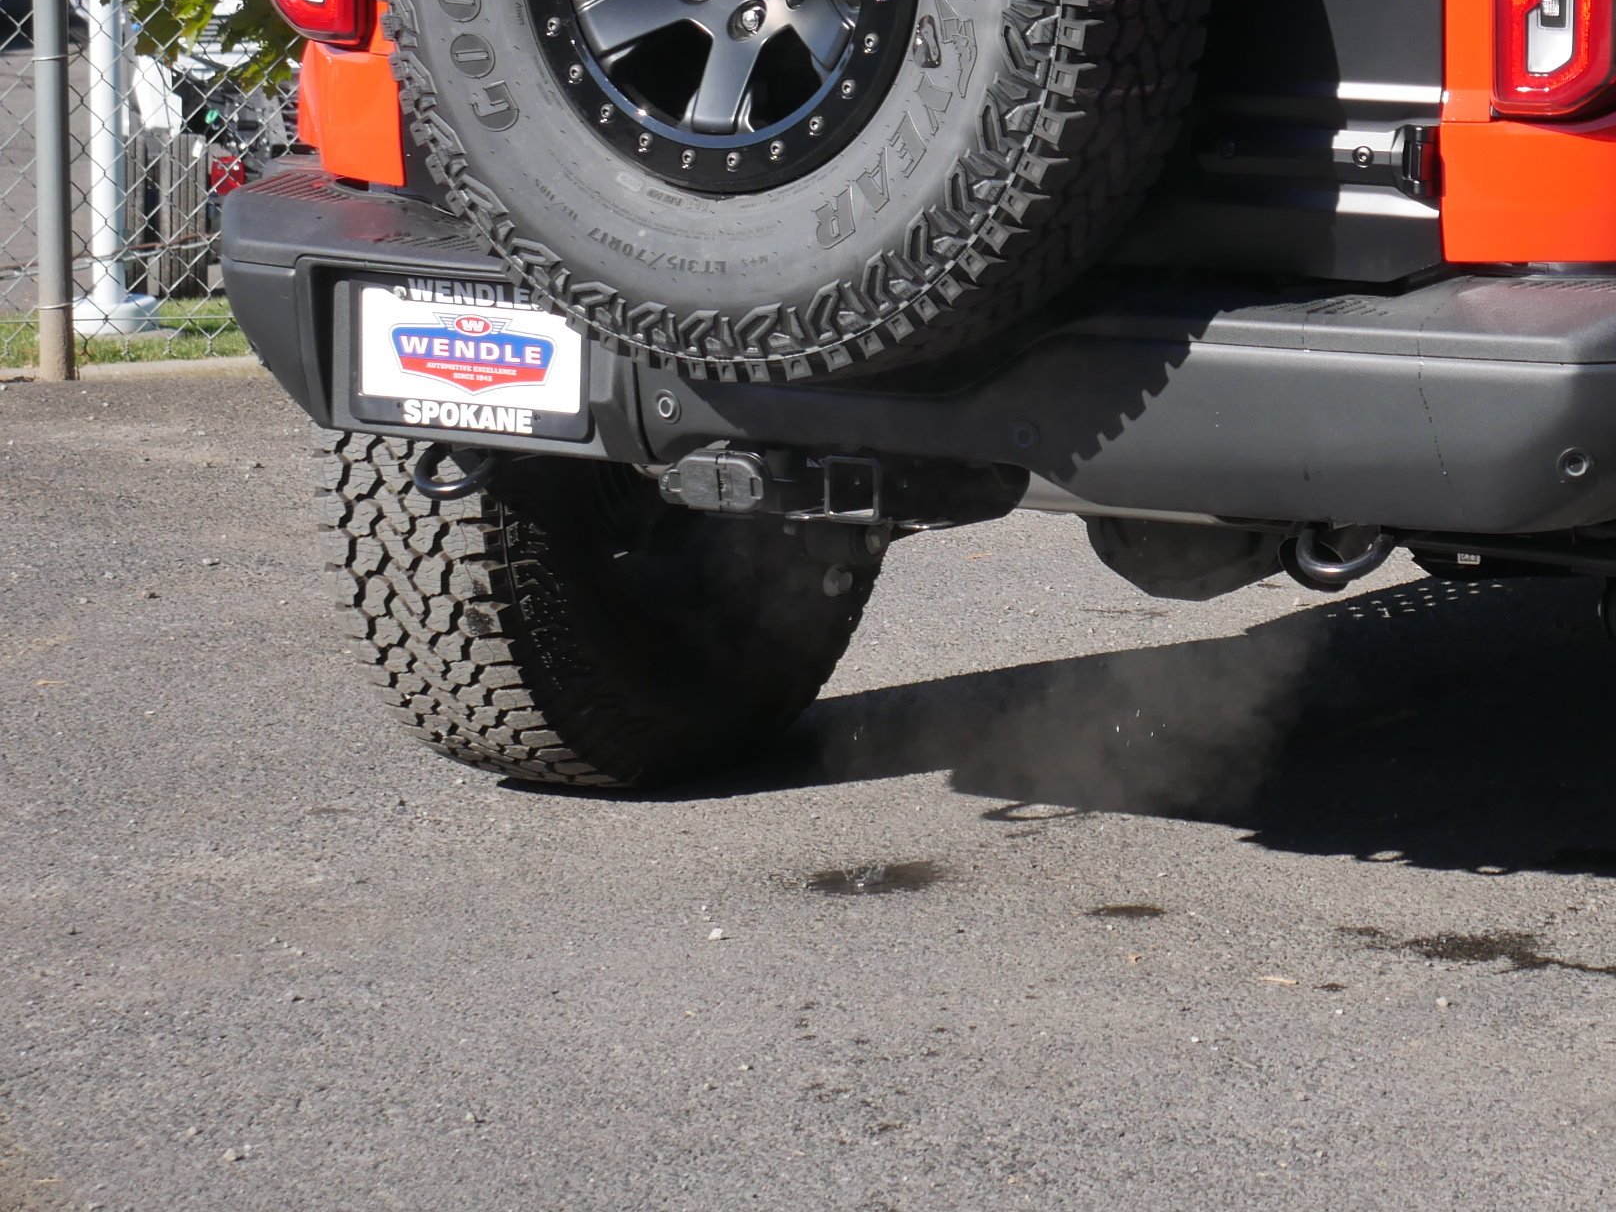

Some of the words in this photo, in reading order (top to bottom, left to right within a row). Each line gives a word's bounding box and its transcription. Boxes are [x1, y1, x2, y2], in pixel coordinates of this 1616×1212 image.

[586, 226, 727, 275] LT315/70R17
[408, 278, 540, 311] WENDLE
[461, 319, 485, 332] W
[400, 336, 542, 365] WENDLE
[426, 362, 472, 372] AUTOMOTIVE
[473, 366, 518, 376] EXCELLENCE
[453, 372, 475, 381] SINCE
[403, 398, 533, 434] SPOKANE
